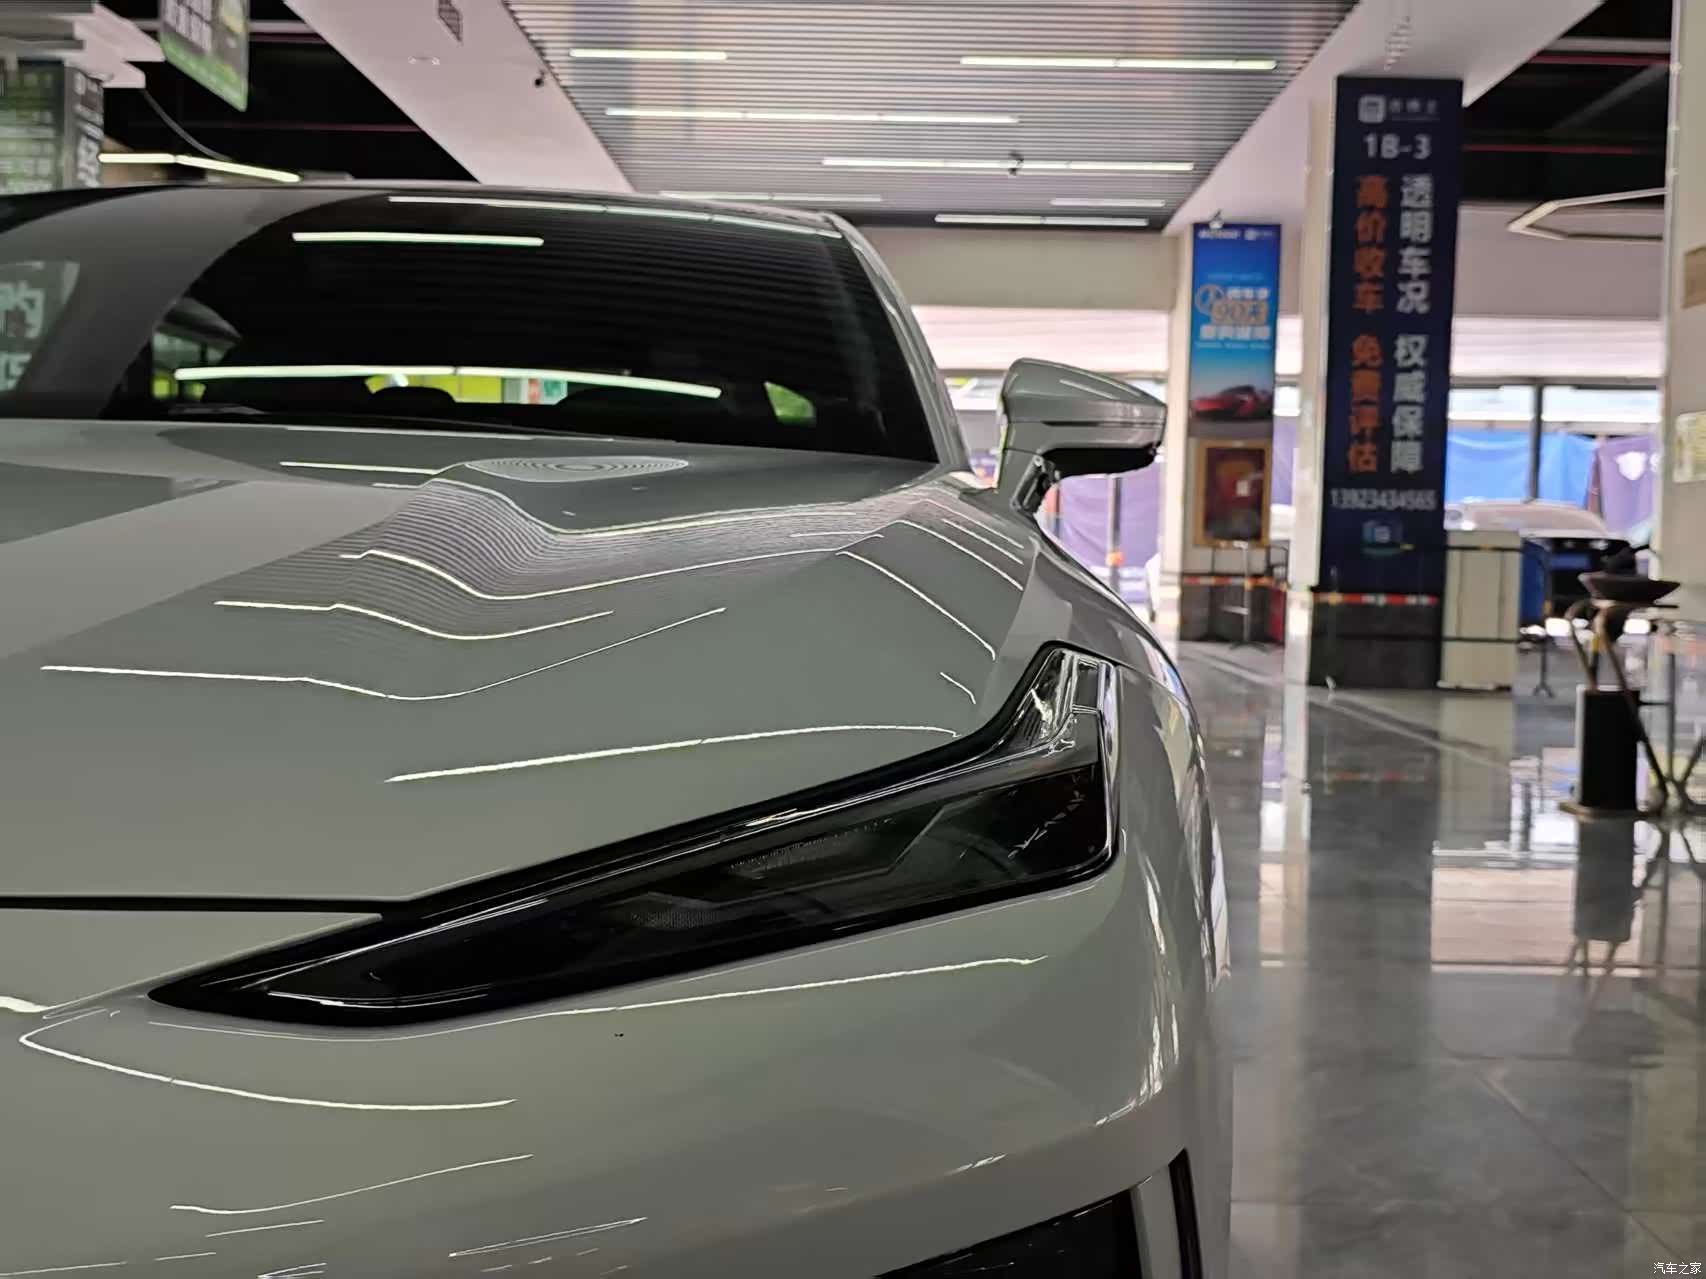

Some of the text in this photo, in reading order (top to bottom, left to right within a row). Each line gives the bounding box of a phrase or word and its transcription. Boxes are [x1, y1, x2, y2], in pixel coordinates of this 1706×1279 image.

[1363, 133, 1431, 159] 1B-3
[1348, 175, 1388, 473] 高价收车 免费评估
[1391, 174, 1434, 474] 透明车况 权威保障
